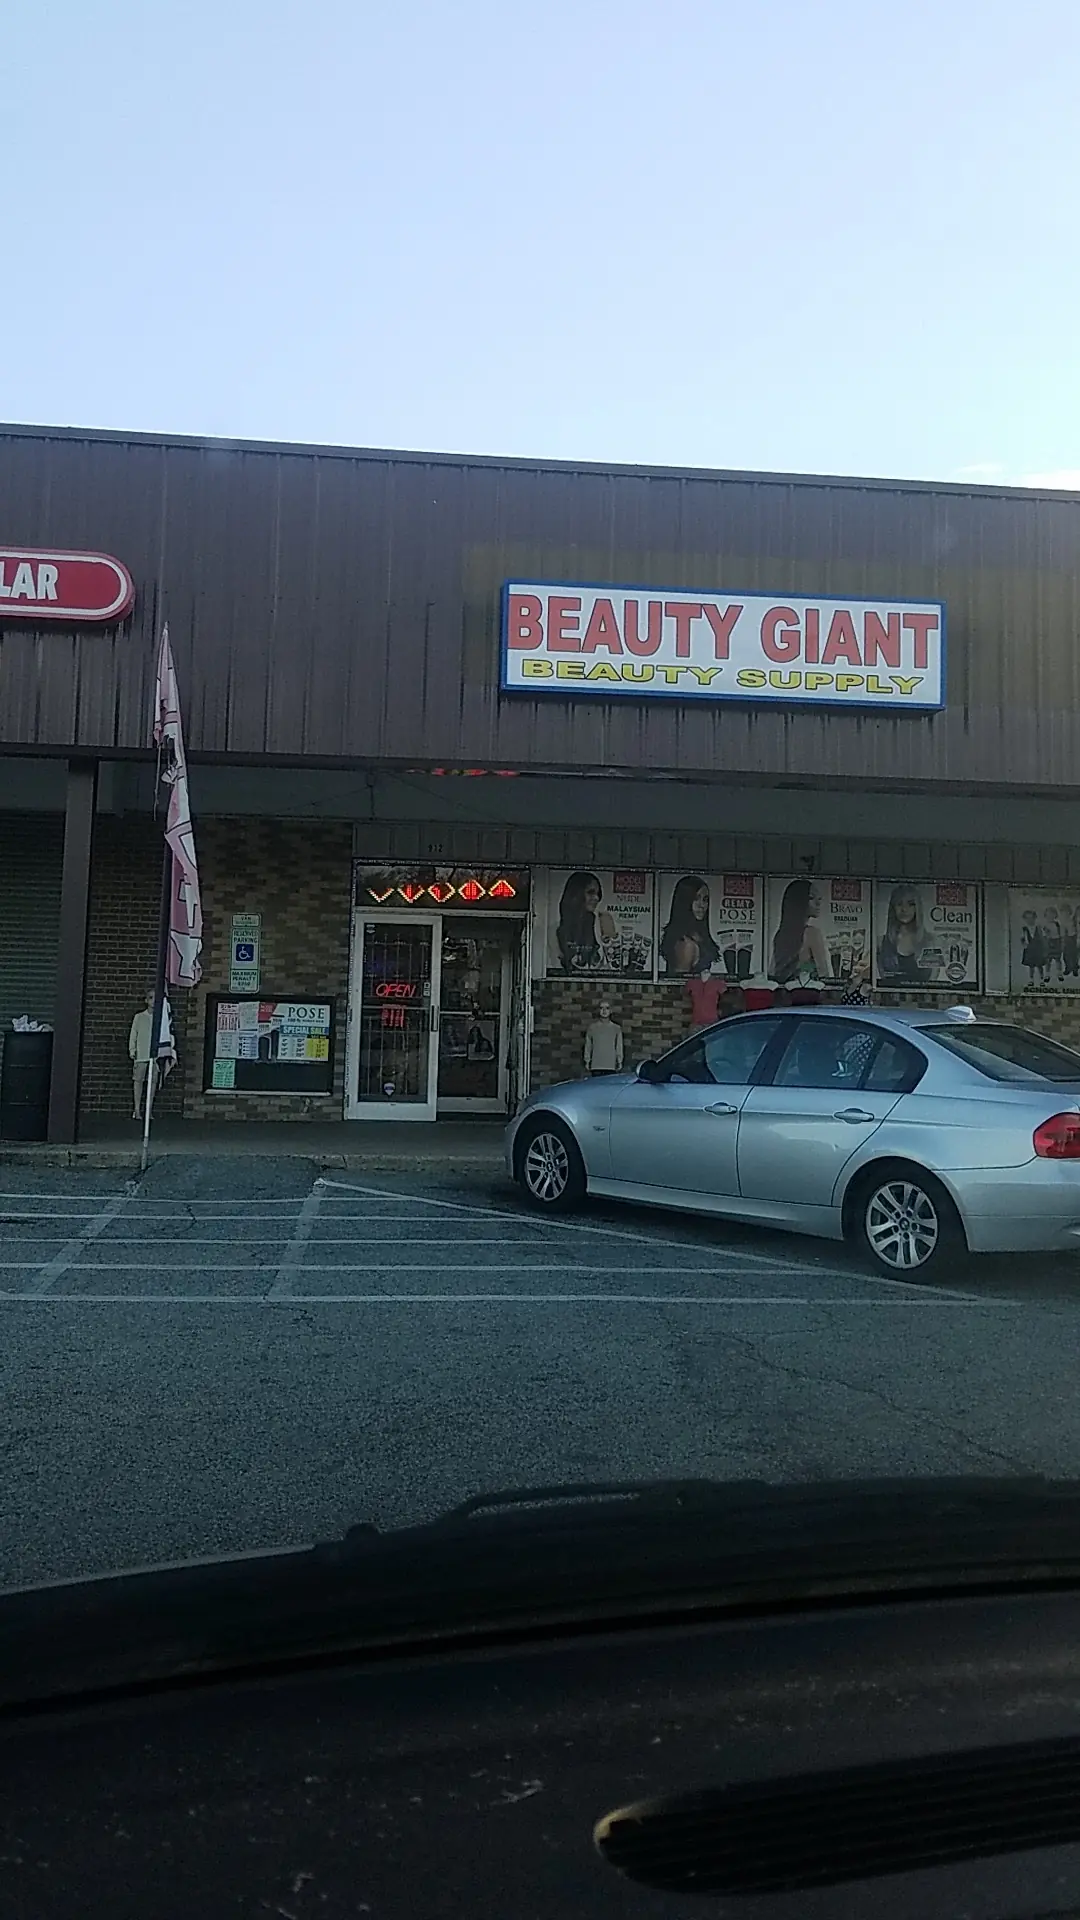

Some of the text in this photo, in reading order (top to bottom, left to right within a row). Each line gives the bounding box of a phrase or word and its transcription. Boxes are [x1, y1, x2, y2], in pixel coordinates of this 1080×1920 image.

[0, 561, 58, 601] LAR
[507, 593, 939, 669] BEAUTY GIANT
[521, 658, 925, 695] BEAUTY SUPPLY
[606, 904, 651, 913] MALAYSIAN
[724, 899, 751, 908] REMY
[830, 902, 863, 914] BRAVO
[719, 908, 756, 920] POSE
[930, 906, 973, 924] Clean
[375, 983, 417, 998] OPEN
[288, 1006, 325, 1020] POSE
[283, 1026, 310, 1035] SPECIAL
